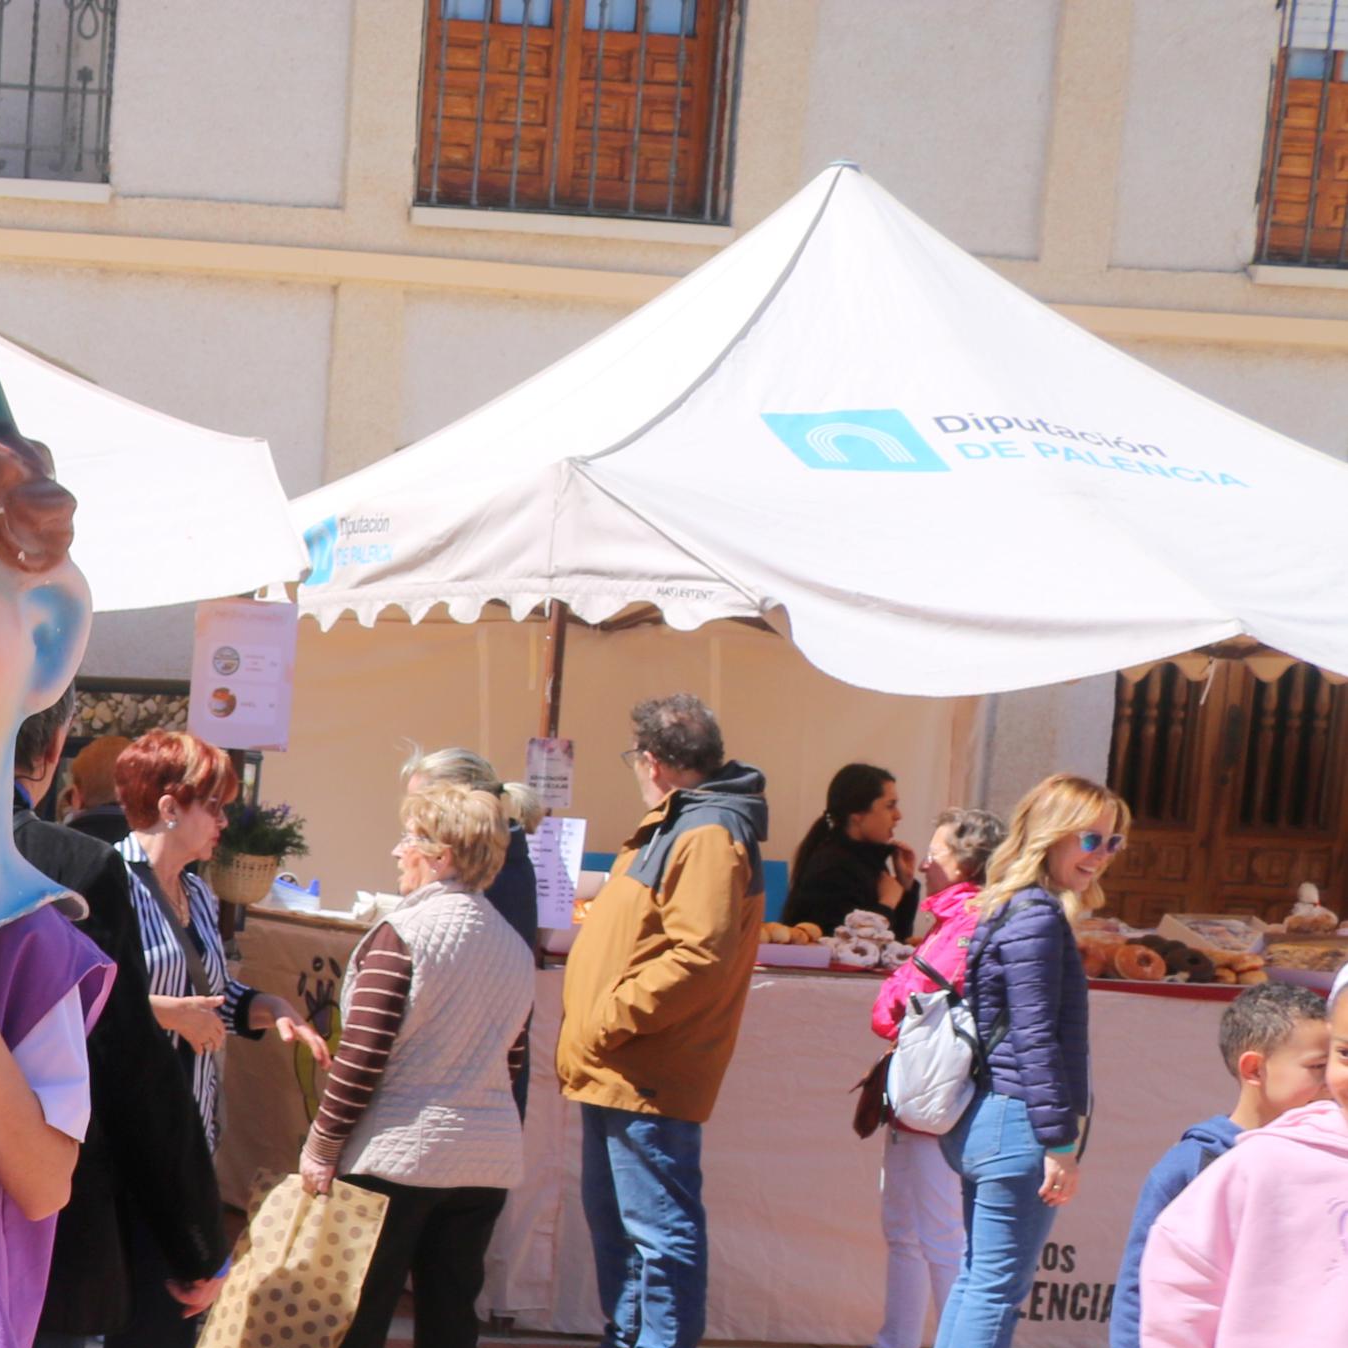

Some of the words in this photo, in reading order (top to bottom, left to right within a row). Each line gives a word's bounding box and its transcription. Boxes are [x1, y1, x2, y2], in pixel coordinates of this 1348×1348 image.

[932, 412, 1168, 458] Diputación
[955, 441, 1025, 460] DE
[1032, 441, 1250, 488] PALENCIA
[1035, 1242, 1076, 1273] OS
